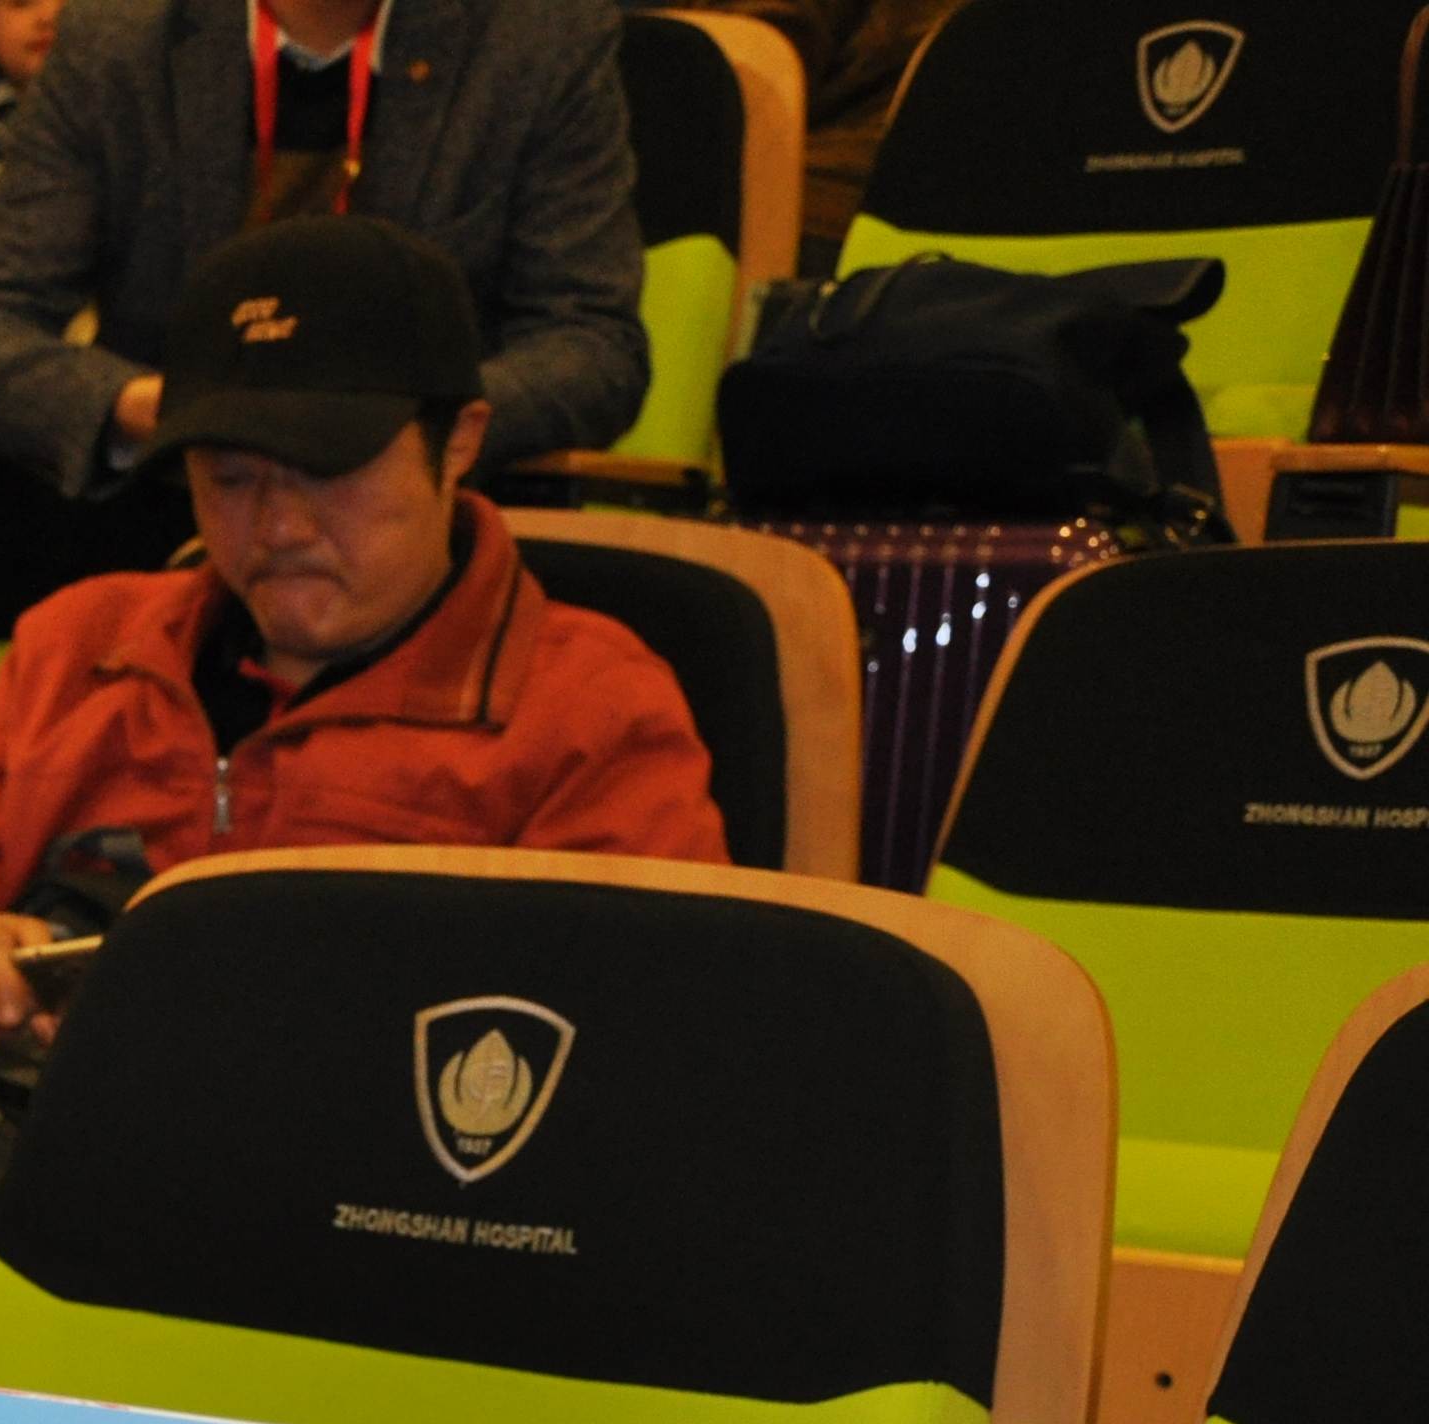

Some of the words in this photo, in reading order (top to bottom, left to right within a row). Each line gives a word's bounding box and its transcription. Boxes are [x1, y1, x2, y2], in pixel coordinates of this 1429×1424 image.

[1373, 806, 1429, 829] HOSP
[333, 1203, 468, 1244] ZHONGSHAN
[472, 1220, 577, 1254] HOSPITAL
